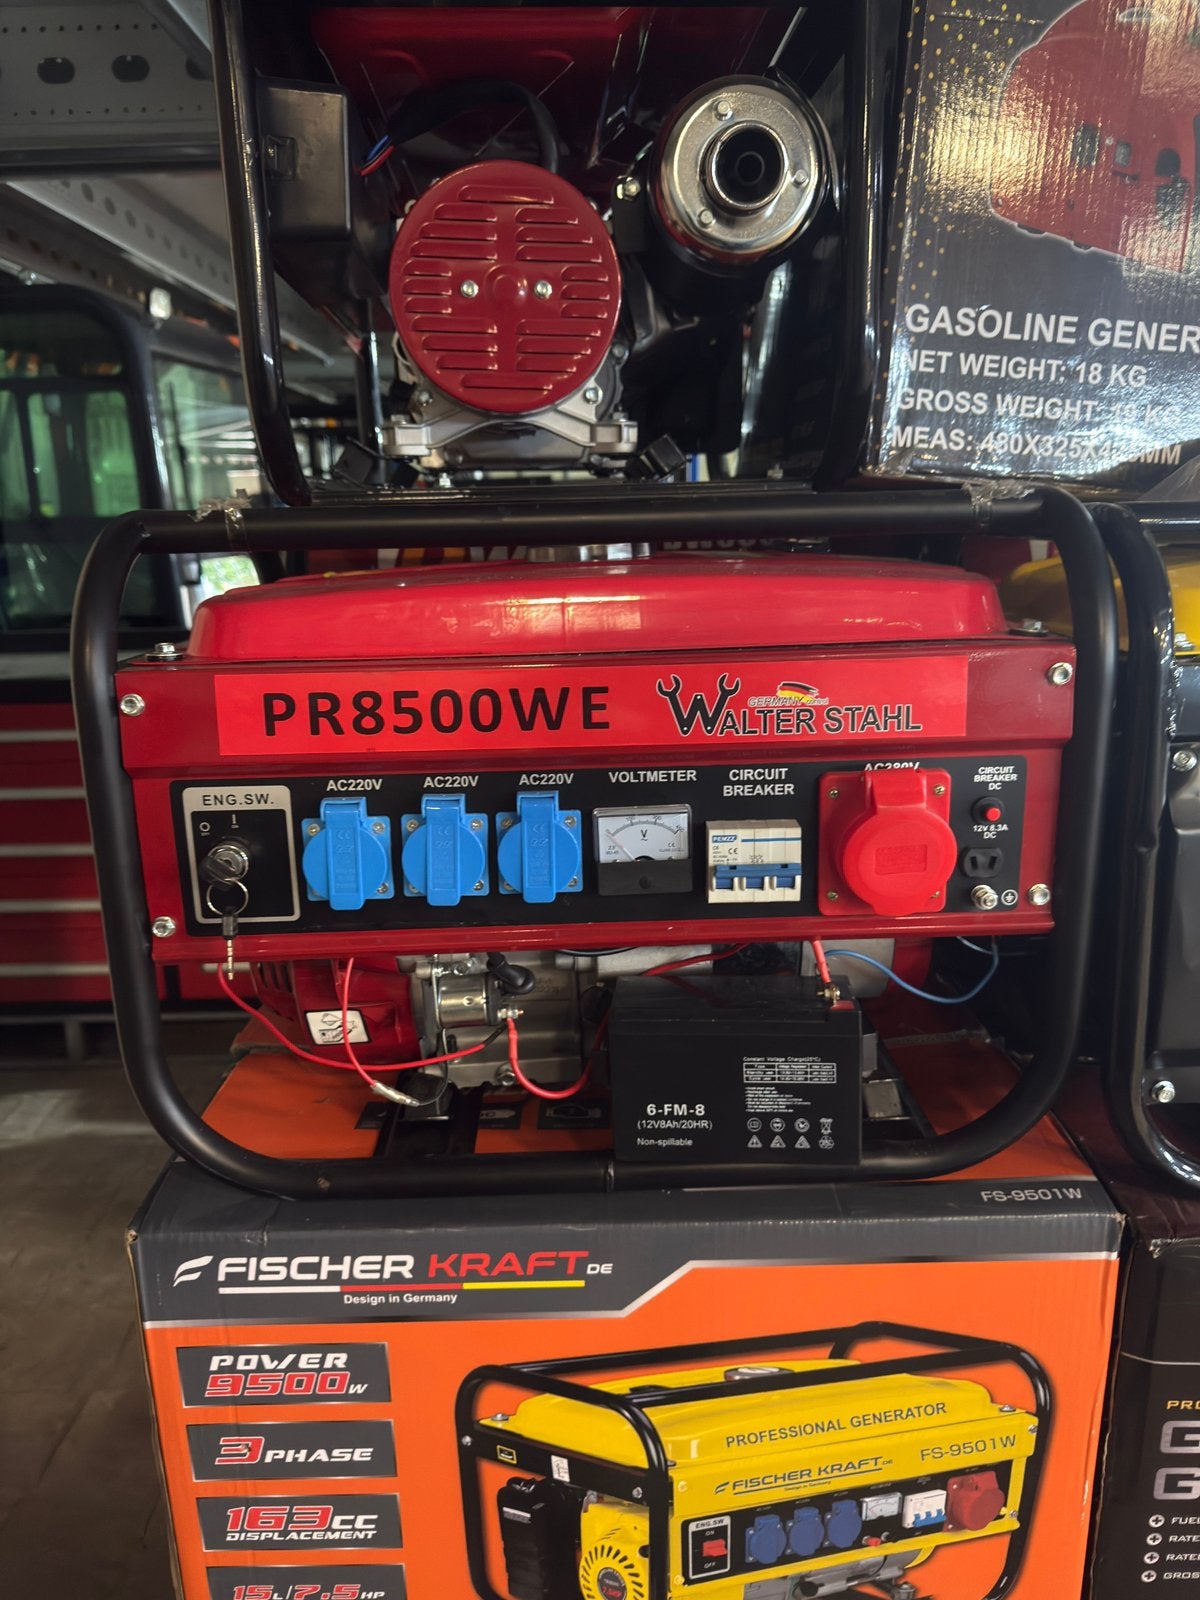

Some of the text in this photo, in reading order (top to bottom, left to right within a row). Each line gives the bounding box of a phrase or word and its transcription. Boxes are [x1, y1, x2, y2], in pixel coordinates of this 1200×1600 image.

[905, 302, 1200, 353] GASOLINE GENER
[903, 348, 1147, 388] NET WEIGHT: 18 KG
[899, 387, 989, 415] GROSS
[891, 425, 974, 452] MEAS:
[262, 686, 610, 737] PR8500WE
[656, 673, 922, 736] WALTER STAHL
[608, 769, 697, 783] VOLTMETER
[728, 767, 788, 781] CIRCUIT
[978, 766, 1015, 774] CIRCUIT
[326, 778, 383, 791] AC220V
[423, 775, 479, 788] AC220V
[518, 772, 574, 785] AC220V
[973, 773, 1018, 782] BREAKER
[722, 783, 794, 797] BREAKER
[202, 793, 275, 806] ENG.SW.
[983, 831, 997, 839] DC
[646, 1103, 706, 1116] 6-FM-8
[637, 1119, 713, 1131] (12V8Ah/20HR)
[636, 1137, 693, 1147] Non-spillable
[980, 1187, 1082, 1202] FS-9501W
[217, 1250, 614, 1281] FISCHER KRAFT DE
[343, 1293, 458, 1306] Design in Germany
[209, 1352, 349, 1371] POWER
[725, 1401, 948, 1448] PROFESSIONAL GENERATOR
[920, 1434, 1017, 1462] FS-9501W
[732, 1470, 812, 1490] FISCHER
[817, 1456, 883, 1476] KRAFT
[225, 1530, 377, 1541] DISPLACEMENT
